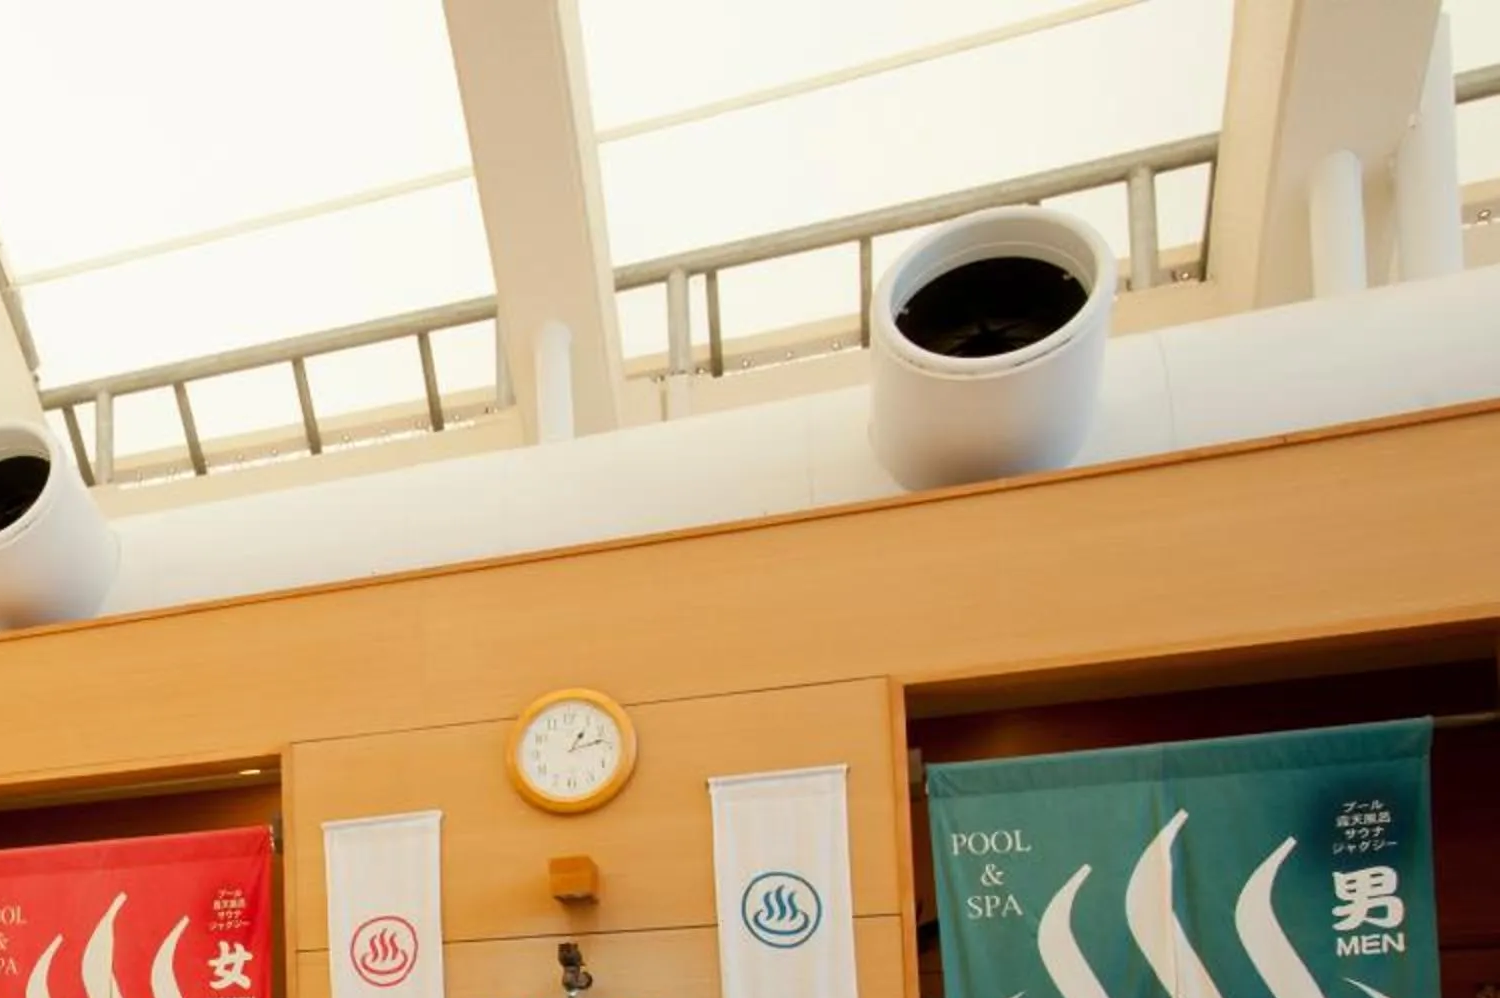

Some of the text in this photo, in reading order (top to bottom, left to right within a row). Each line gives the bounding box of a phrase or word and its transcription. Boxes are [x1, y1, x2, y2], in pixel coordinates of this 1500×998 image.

[1342, 800, 1384, 813] プール
[1336, 811, 1391, 828] 露天風呂
[951, 829, 1032, 856] POOL
[1344, 826, 1385, 840] サウナ
[1332, 839, 1398, 855] ジャグジー
[981, 863, 1004, 887] &
[967, 894, 1024, 919] SPA
[1331, 865, 1405, 931] 男
[1336, 932, 1405, 957] MEN
[208, 940, 253, 990] 女
